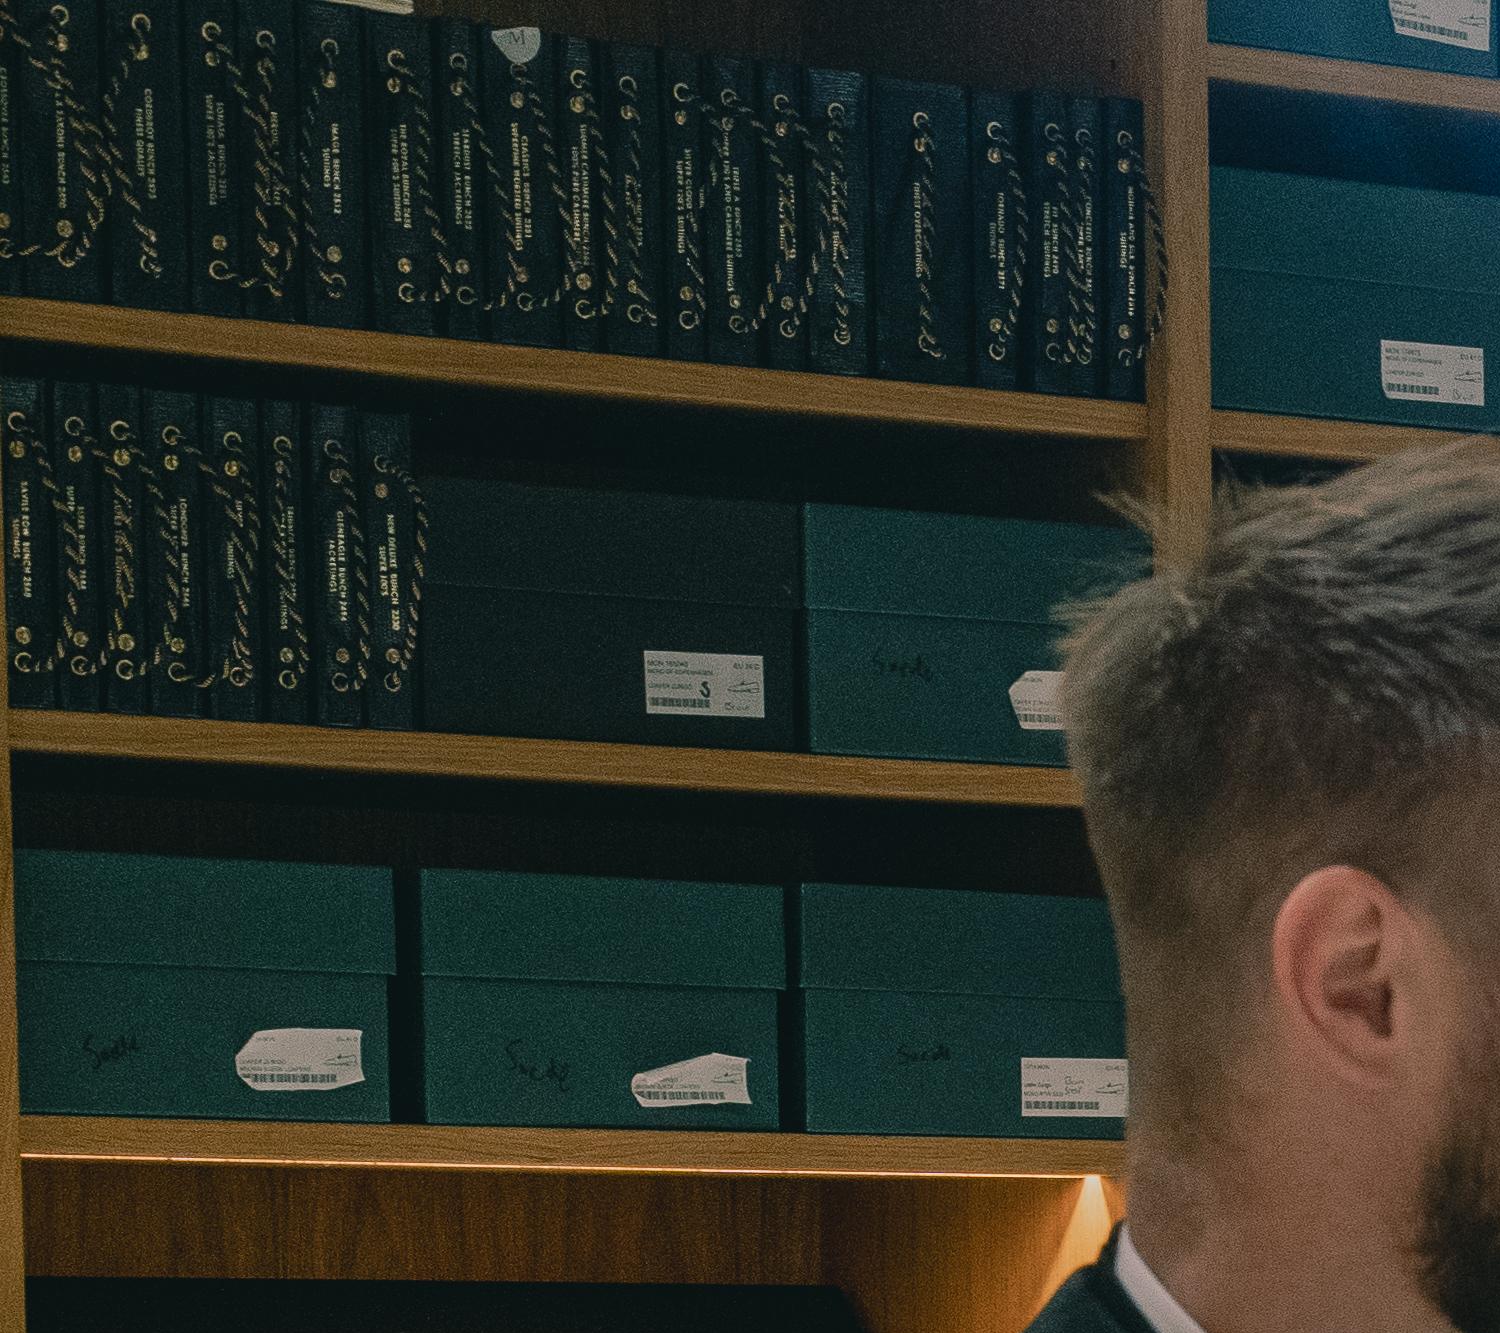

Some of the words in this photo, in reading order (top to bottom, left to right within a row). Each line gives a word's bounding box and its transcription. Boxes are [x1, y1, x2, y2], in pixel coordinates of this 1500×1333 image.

[146, 142, 156, 175] BUNCH
[217, 144, 226, 175] BUNCH
[332, 158, 341, 190] BUNCH
[401, 174, 410, 206] BUNCH
[463, 175, 472, 207] BUNCH
[522, 182, 531, 213] BUNCH
[997, 238, 1006, 268] BUNCH
[1051, 223, 1060, 252] BUNCH
[22, 514, 31, 537] ROW
[386, 514, 395, 535] NEW
[22, 541, 32, 574] BUNCH
[181, 552, 190, 583] BUNCH
[378, 546, 388, 571] SUPER
[387, 537, 397, 569] DELUXE
[338, 566, 346, 598] BUNCH
[389, 573, 399, 605] BUNCH
